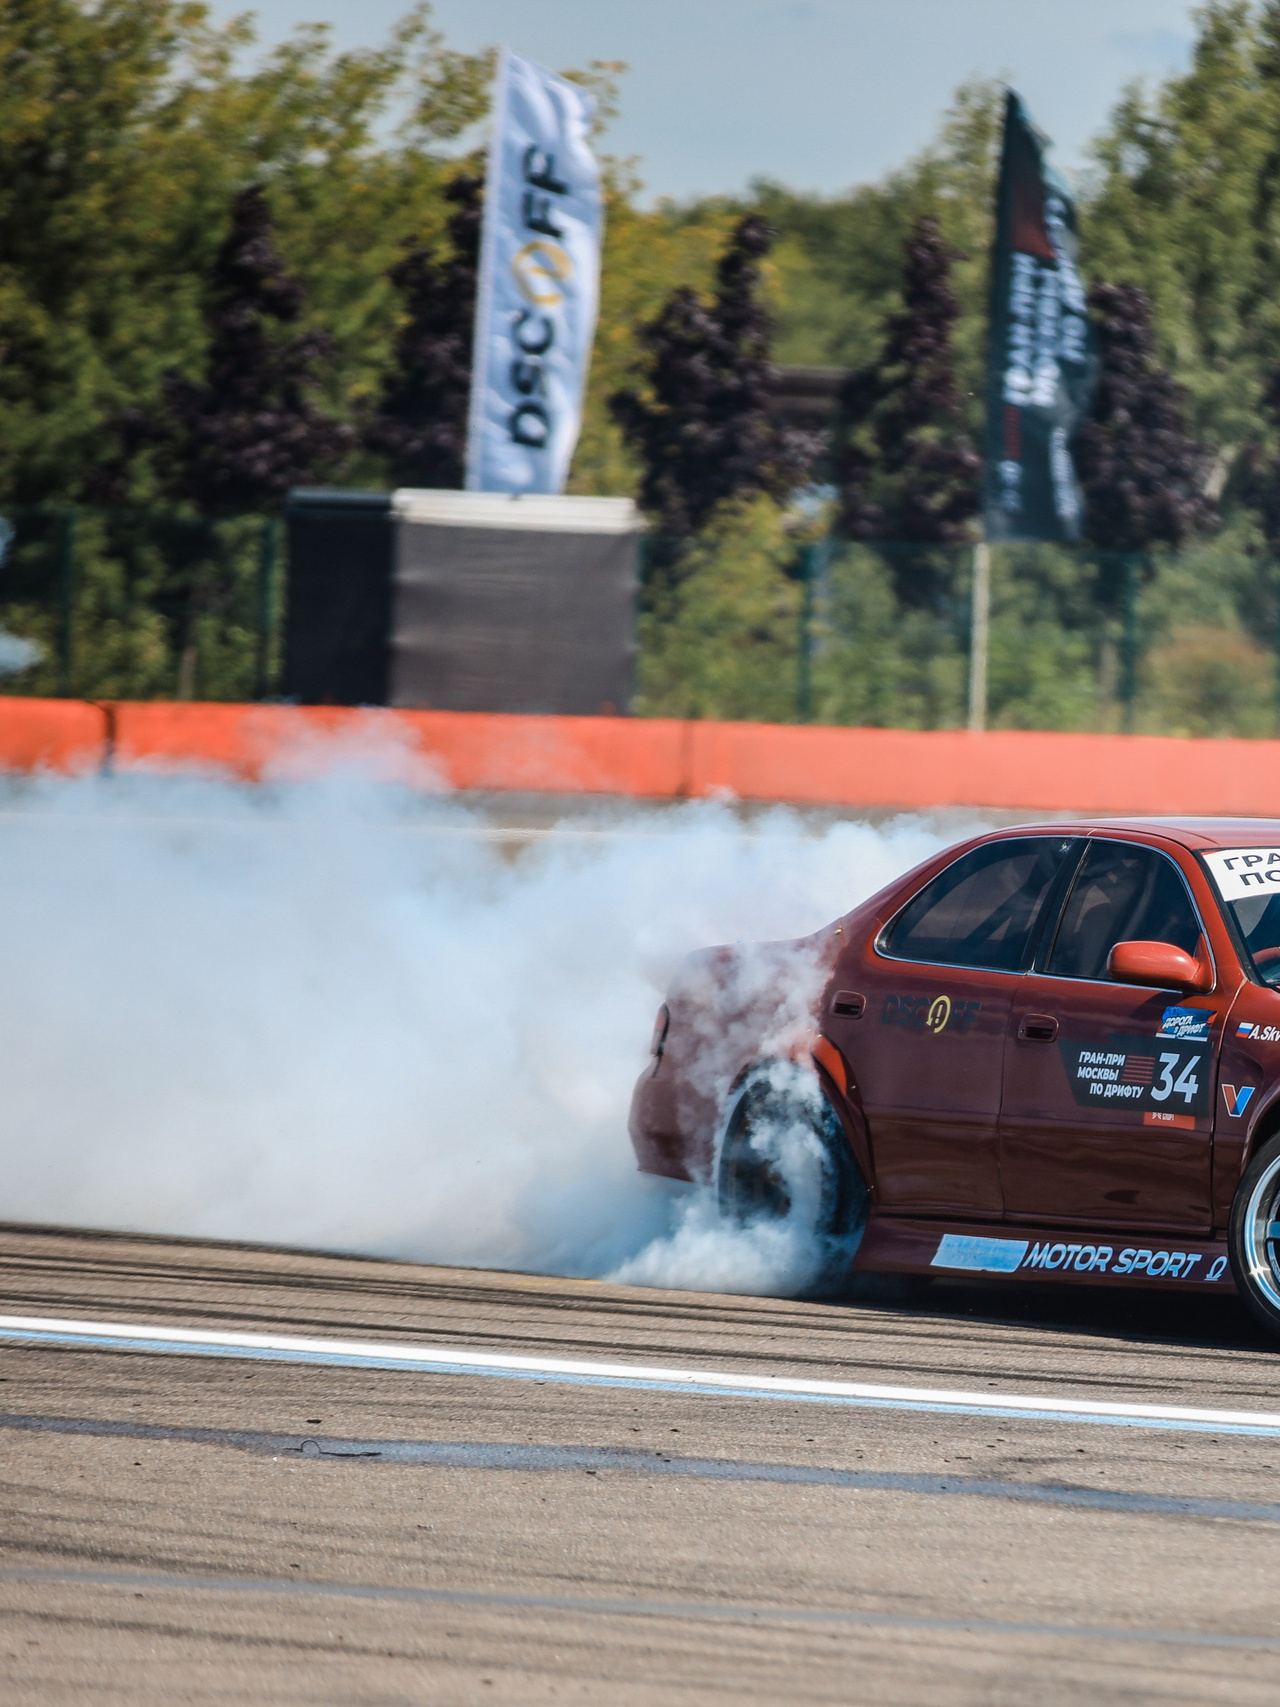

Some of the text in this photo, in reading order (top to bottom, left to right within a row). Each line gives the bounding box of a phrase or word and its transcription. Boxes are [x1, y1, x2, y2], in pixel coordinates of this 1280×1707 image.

[1078, 1051, 1126, 1067] ГРАН-ПРИ
[1077, 1066, 1119, 1081] МОСКВЫ
[1150, 1052, 1201, 1104] 34
[1089, 1083, 1144, 1099] ПО ДРИФТУ
[1022, 1242, 1202, 1279] MOTOR SPORT
